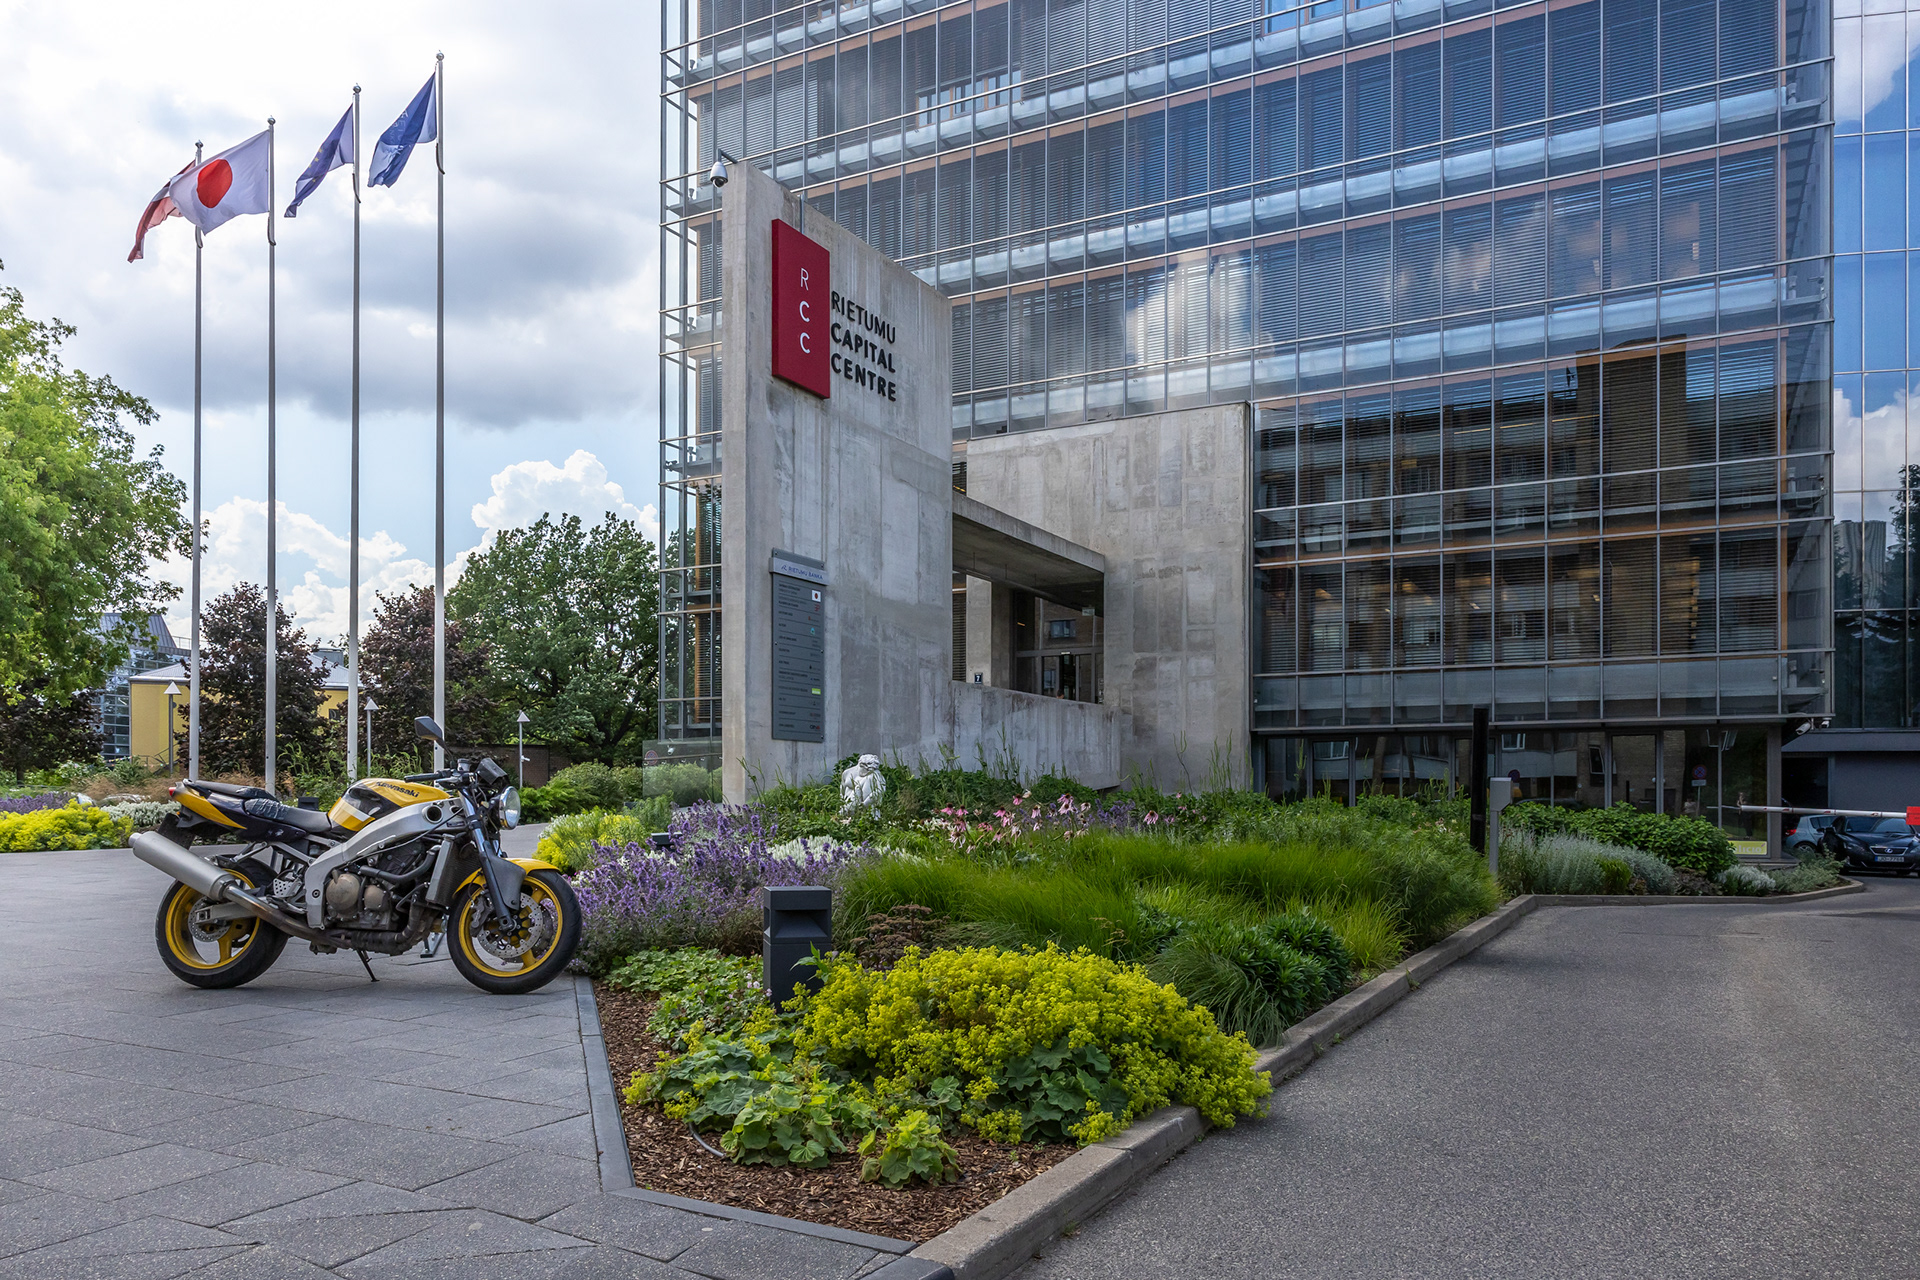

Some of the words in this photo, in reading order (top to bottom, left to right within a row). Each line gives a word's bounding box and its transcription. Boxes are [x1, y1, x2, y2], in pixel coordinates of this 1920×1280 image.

[831, 290, 896, 344] RIETUMU
[831, 323, 896, 373] CAPITAL
[831, 353, 896, 402] CENTRE
[808, 571, 823, 580] BANKA
[376, 781, 420, 798] Kawasaki
